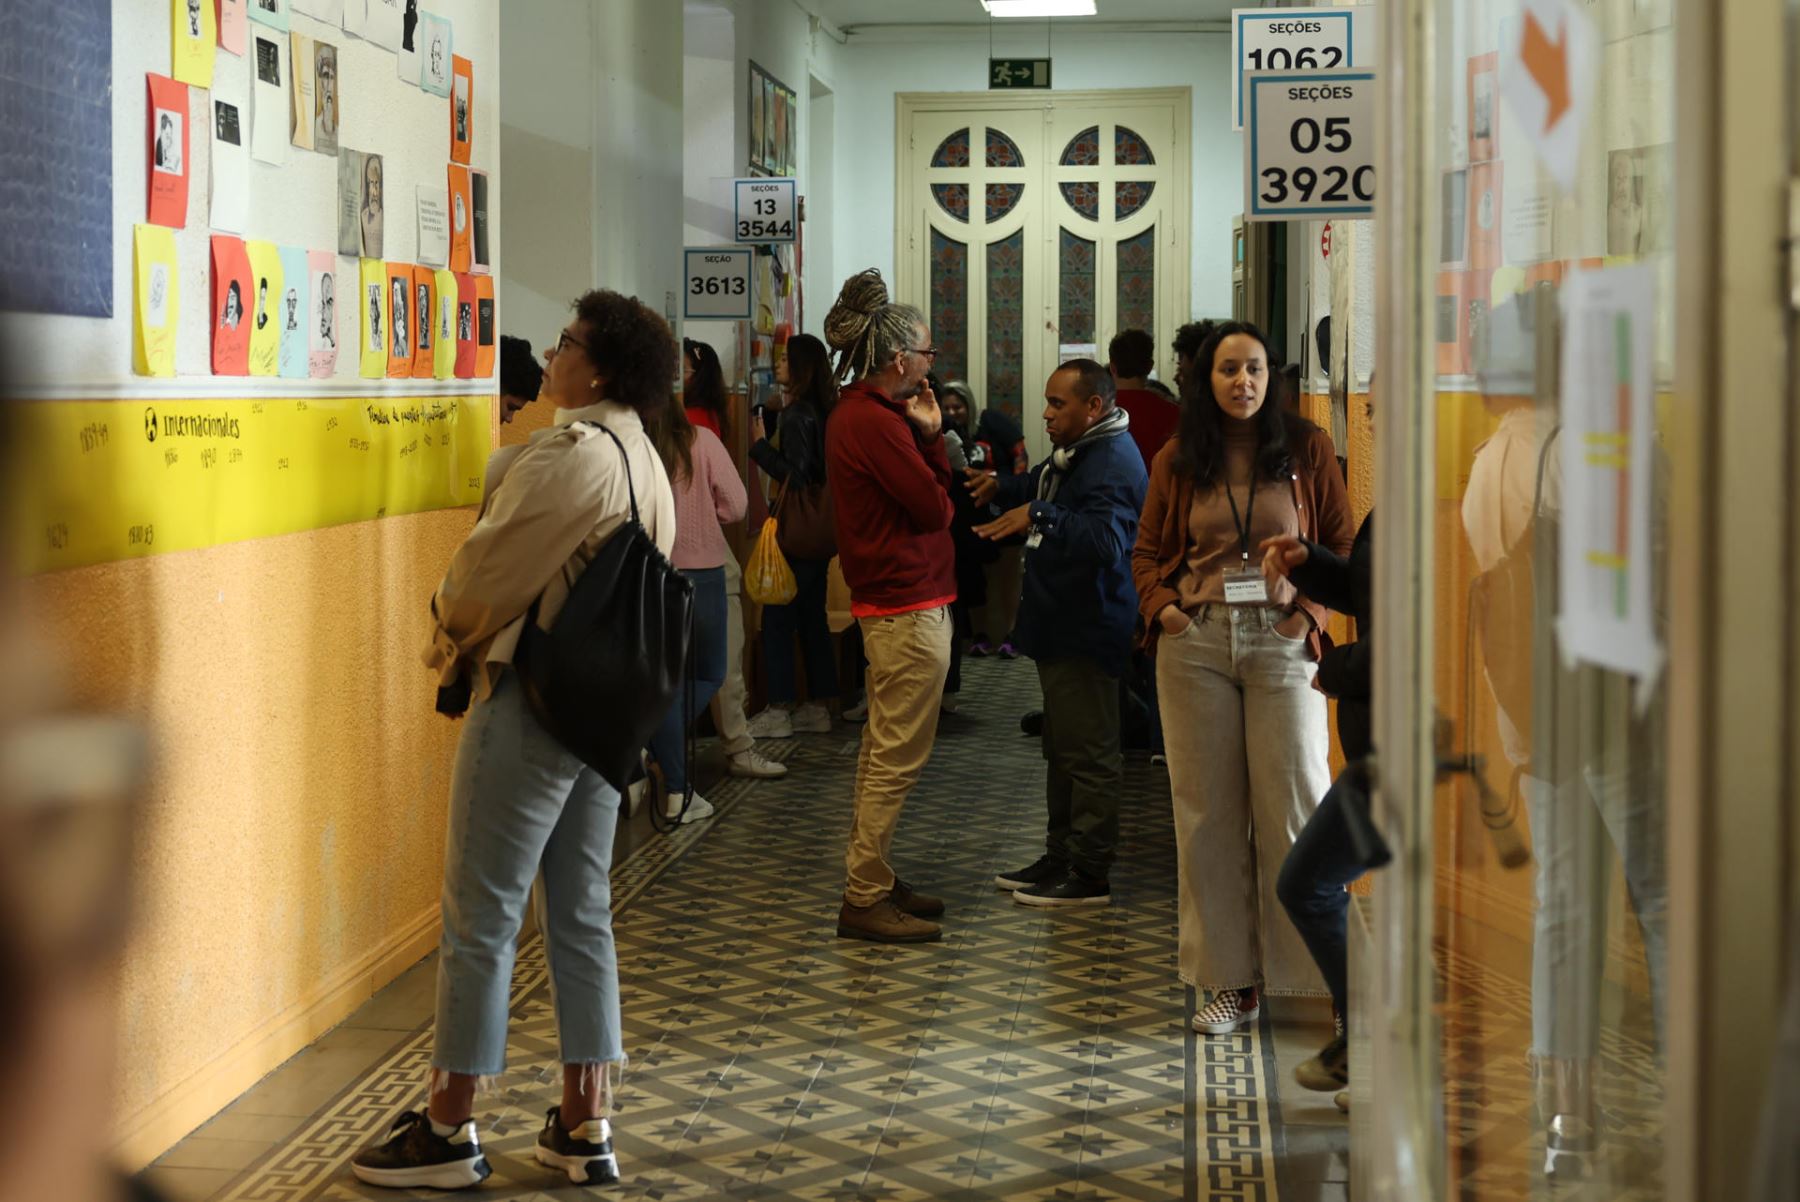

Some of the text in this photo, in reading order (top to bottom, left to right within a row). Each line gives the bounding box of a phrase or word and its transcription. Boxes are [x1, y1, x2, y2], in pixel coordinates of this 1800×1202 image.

[1269, 20, 1322, 36] SEÇÕES
[1248, 46, 1343, 70] 1062
[1288, 84, 1353, 103] SEÇÕES
[1290, 117, 1352, 154] 05
[751, 184, 779, 193] SEÇÕES
[754, 199, 777, 215] 13
[738, 220, 793, 237] 3544
[704, 254, 732, 264] SEÇÃO
[690, 276, 745, 295] 3613
[163, 411, 240, 439] Internacionales
